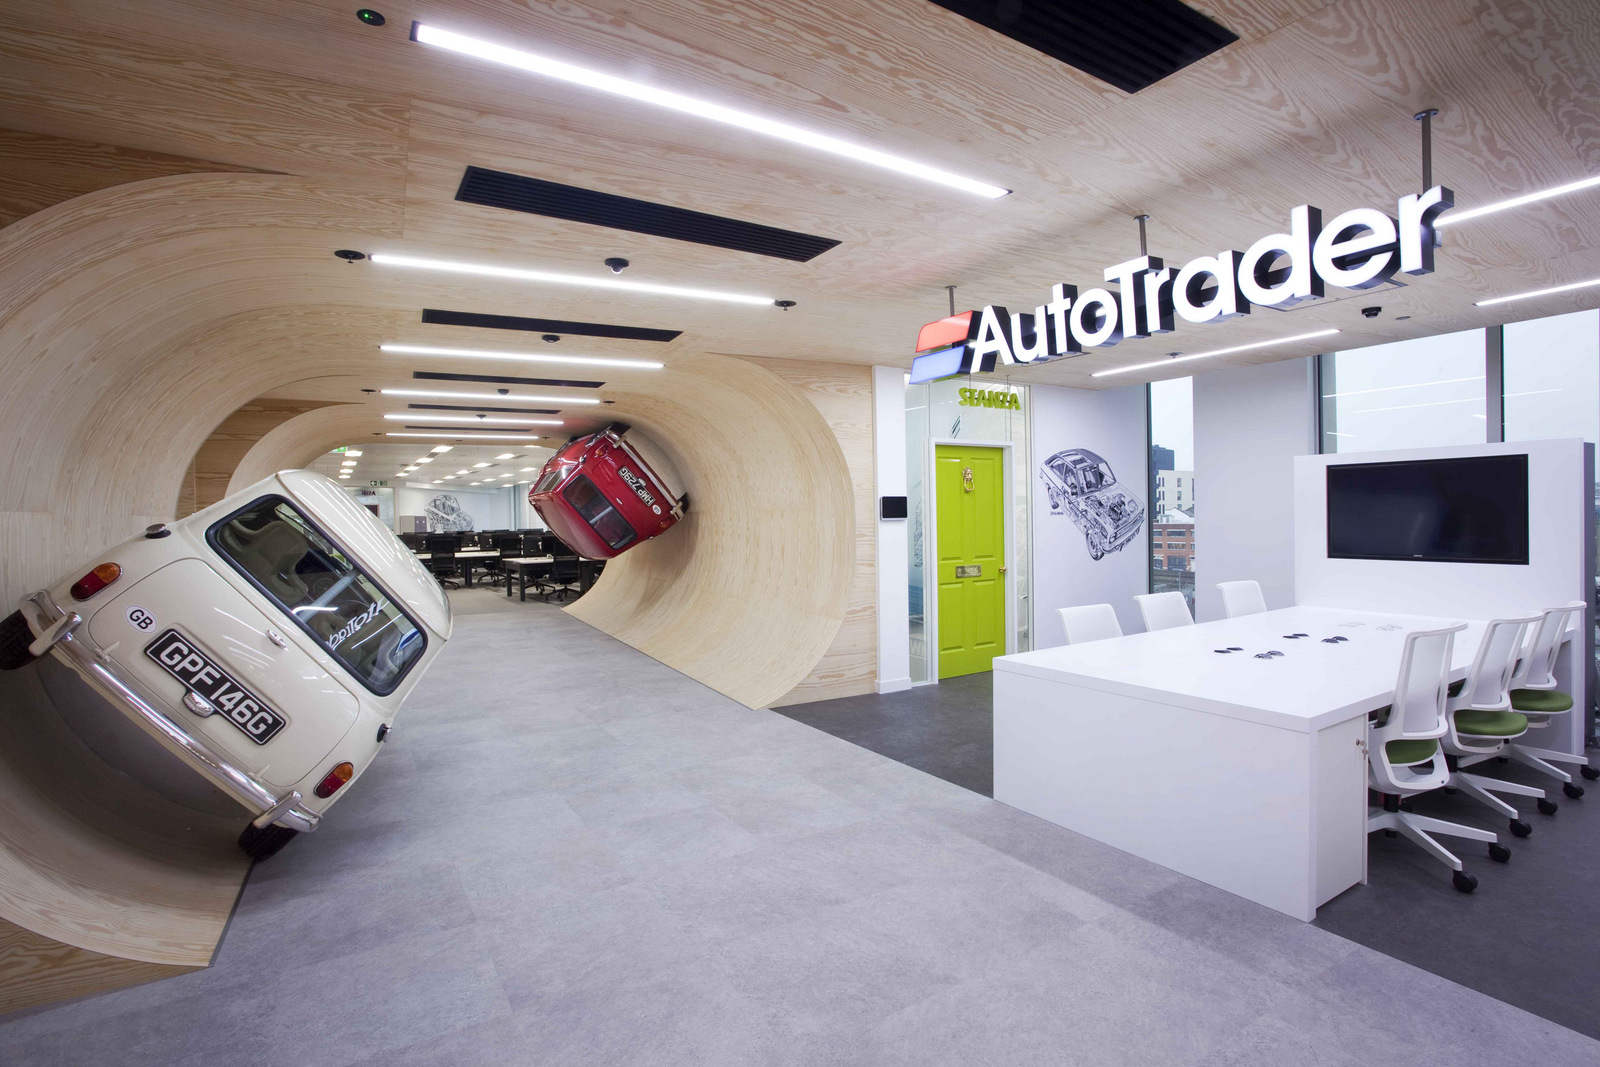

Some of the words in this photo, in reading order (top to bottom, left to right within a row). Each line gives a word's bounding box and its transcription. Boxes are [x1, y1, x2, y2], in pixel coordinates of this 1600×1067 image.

[969, 185, 1453, 374] AutoTrader
[958, 387, 1021, 410] STANZA
[620, 468, 641, 490] 729G
[637, 489, 654, 505] HMP
[129, 609, 154, 630] GB
